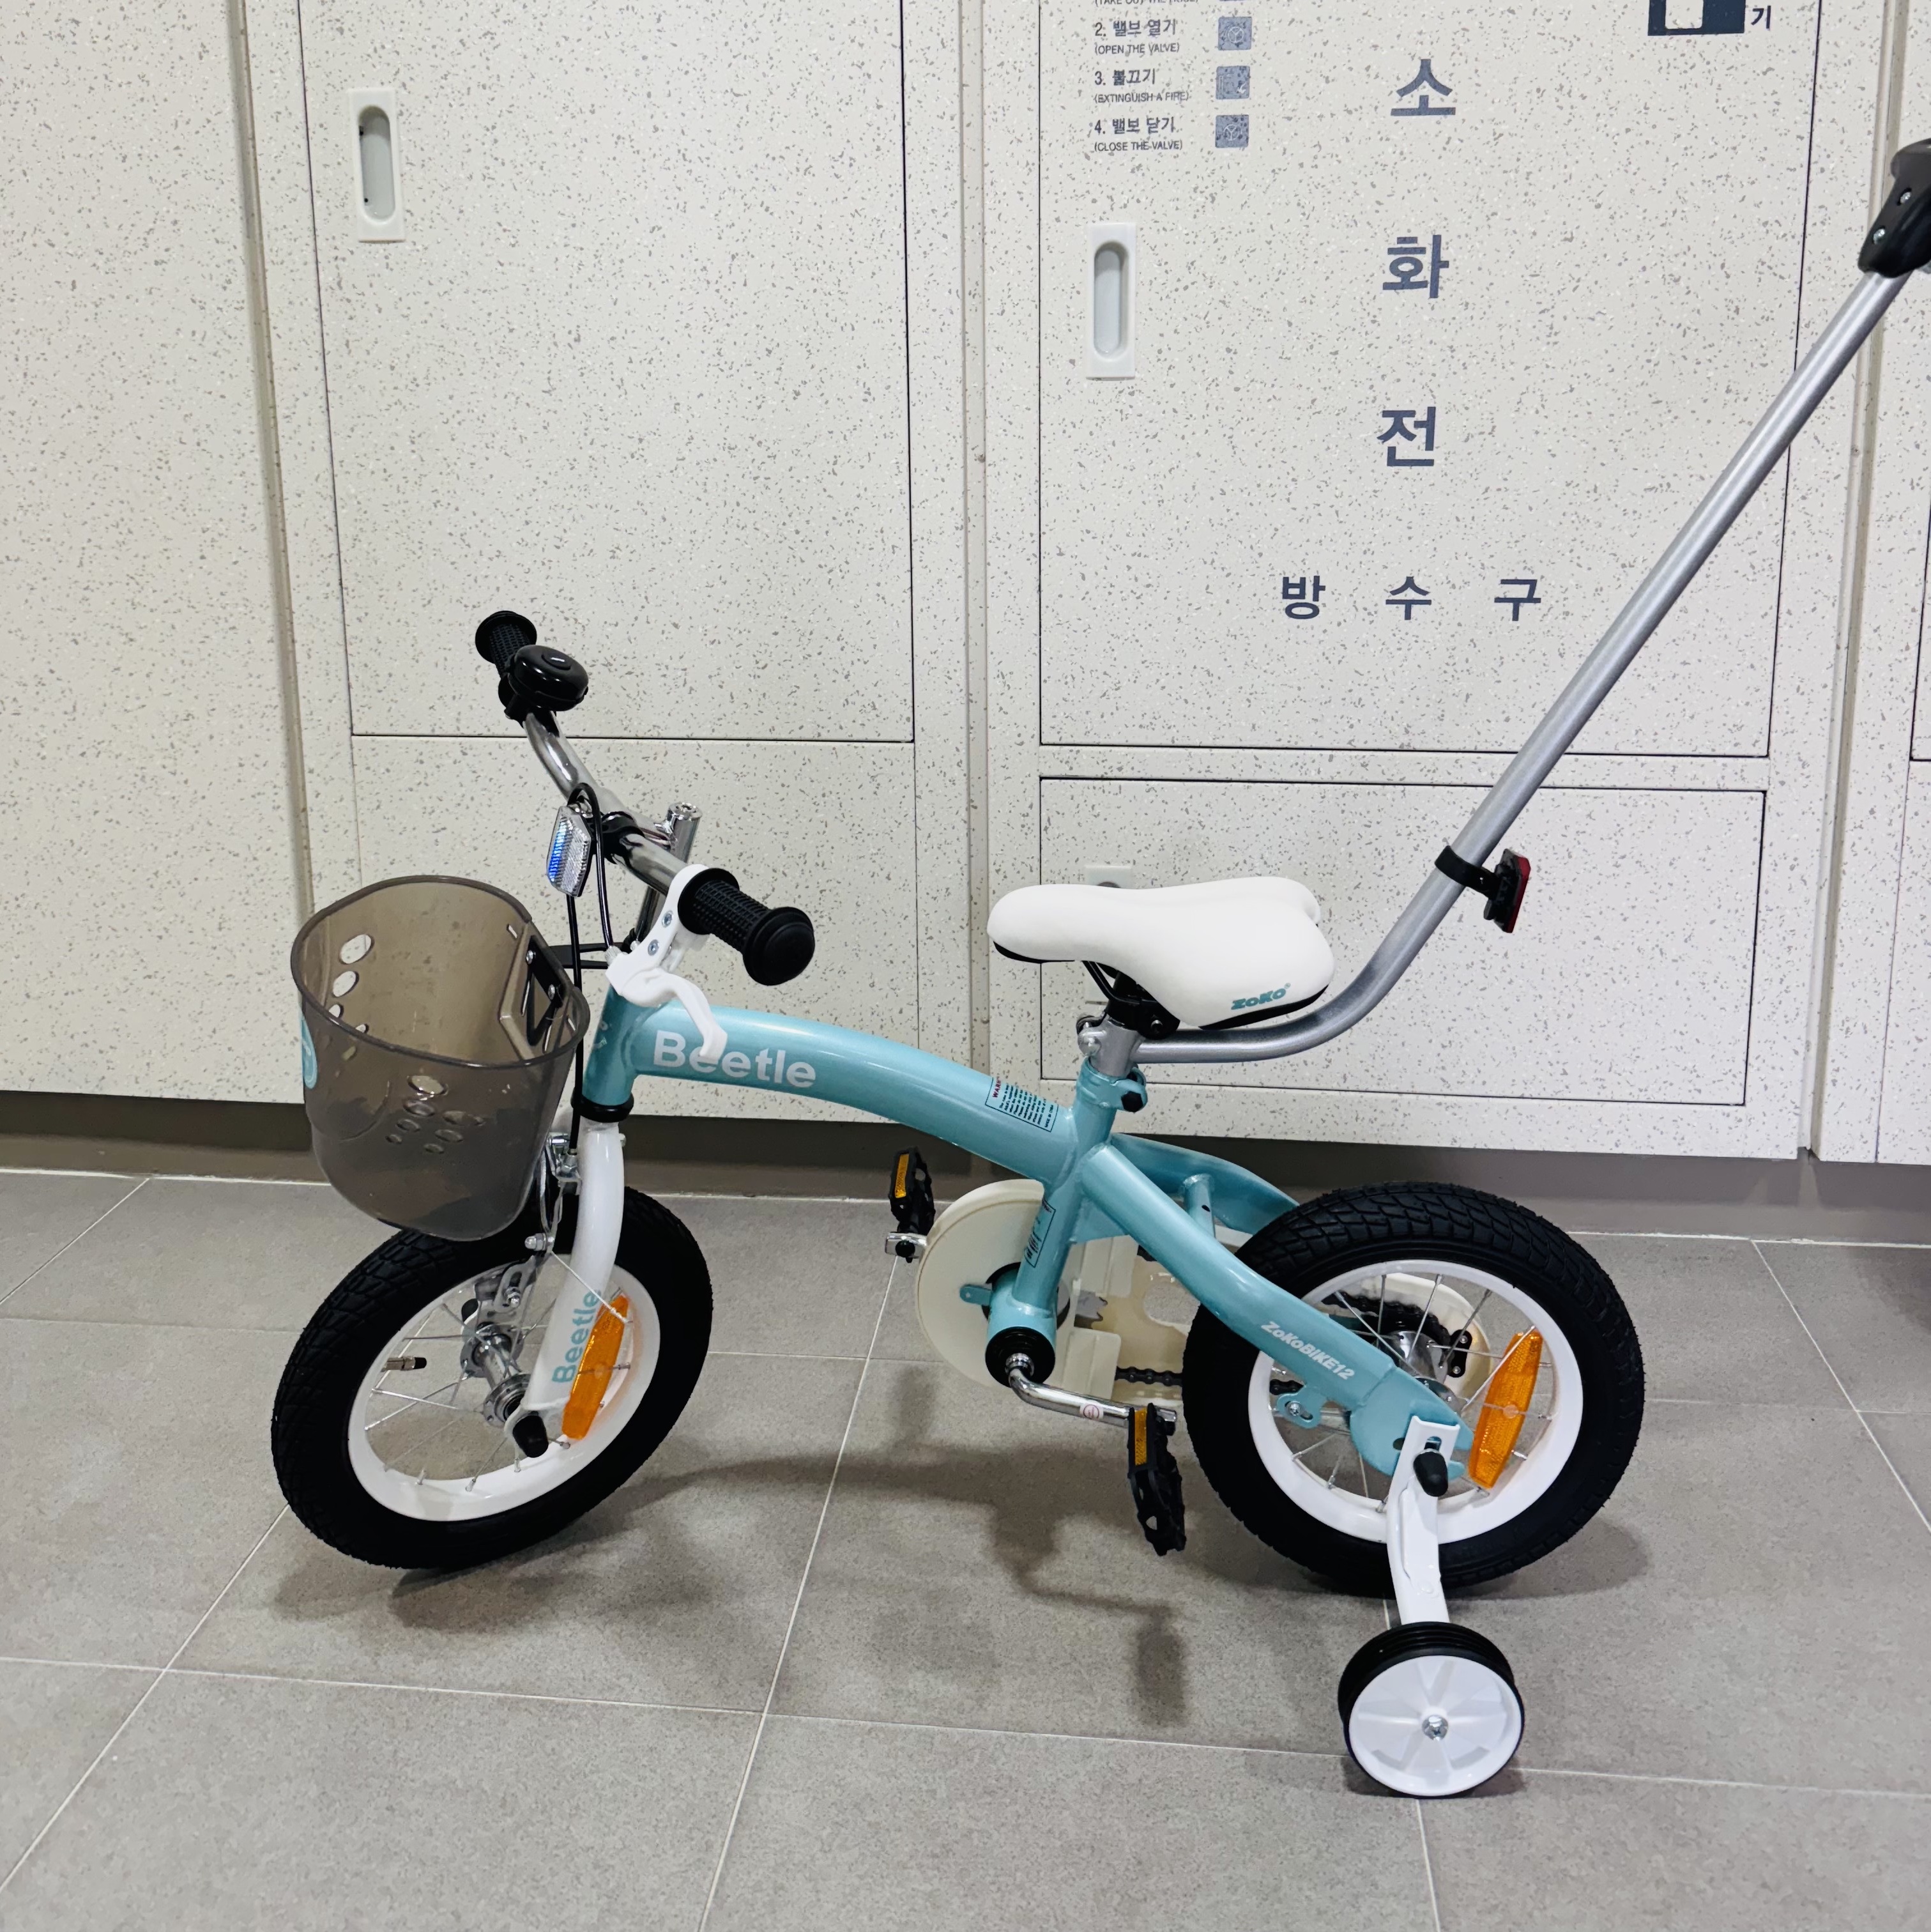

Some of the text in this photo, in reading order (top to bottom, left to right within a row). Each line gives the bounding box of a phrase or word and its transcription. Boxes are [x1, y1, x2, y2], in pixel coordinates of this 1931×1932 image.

[1750, 5, 1771, 29] 기
[1095, 22, 1106, 36] 2.
[1147, 19, 1176, 36] 열기
[1095, 42, 1180, 56] (OPEN THE VALVE)
[1094, 68, 1156, 86] 3. 불끄기
[1094, 91, 1189, 103] (EXTINGUISH A FIRE)
[1094, 119, 1106, 134] 4.
[1147, 116, 1174, 134] 닫기
[1094, 139, 1182, 151] (CLOSE THE VALVE)
[1377, 59, 1456, 466] 소 화 전
[1282, 576, 1541, 622] 방 수 구
[552, 1289, 602, 1383] Beetle
